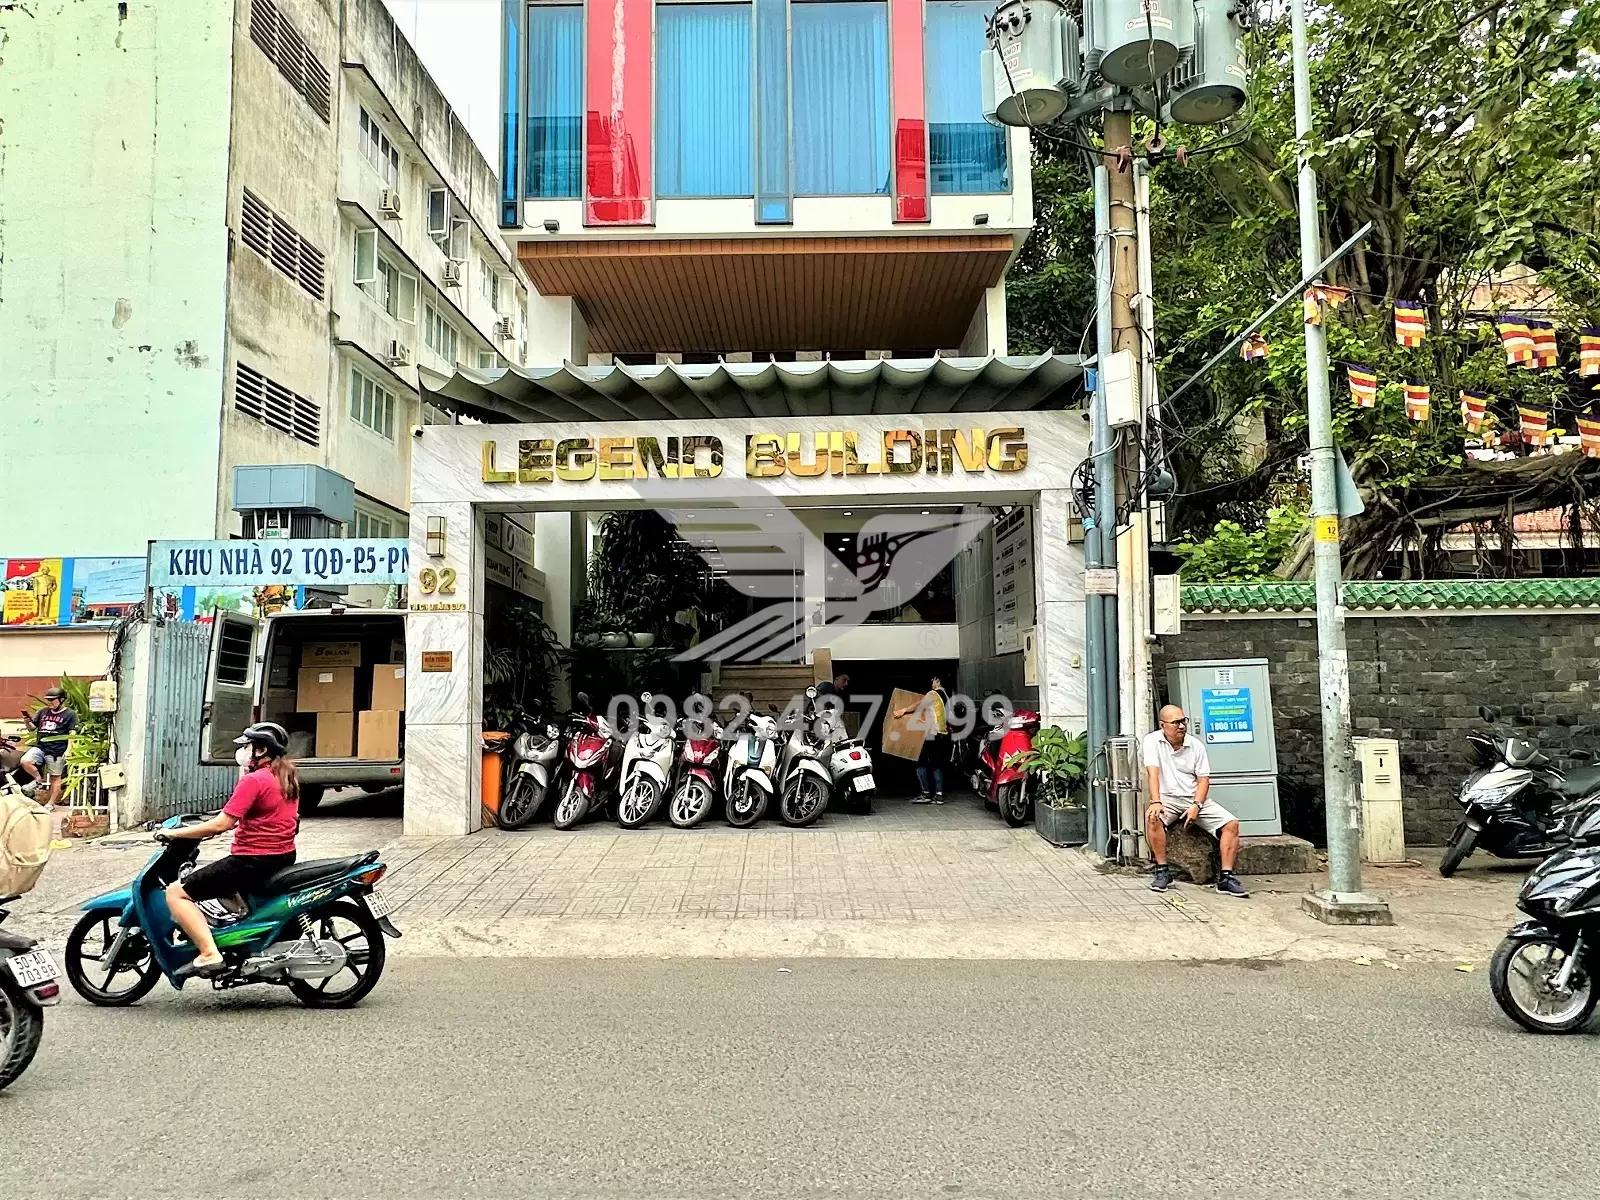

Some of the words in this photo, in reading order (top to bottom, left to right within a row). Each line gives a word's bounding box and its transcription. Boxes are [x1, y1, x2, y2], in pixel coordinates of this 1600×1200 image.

[482, 434, 723, 484] LEGEND
[745, 427, 1028, 479] BUILDING
[1327, 526, 1336, 535] 12
[169, 549, 213, 576] KHU
[219, 542, 264, 576] NHÀ
[271, 548, 293, 575] 92
[419, 567, 457, 595] 92
[1209, 722, 1228, 731] 1800
